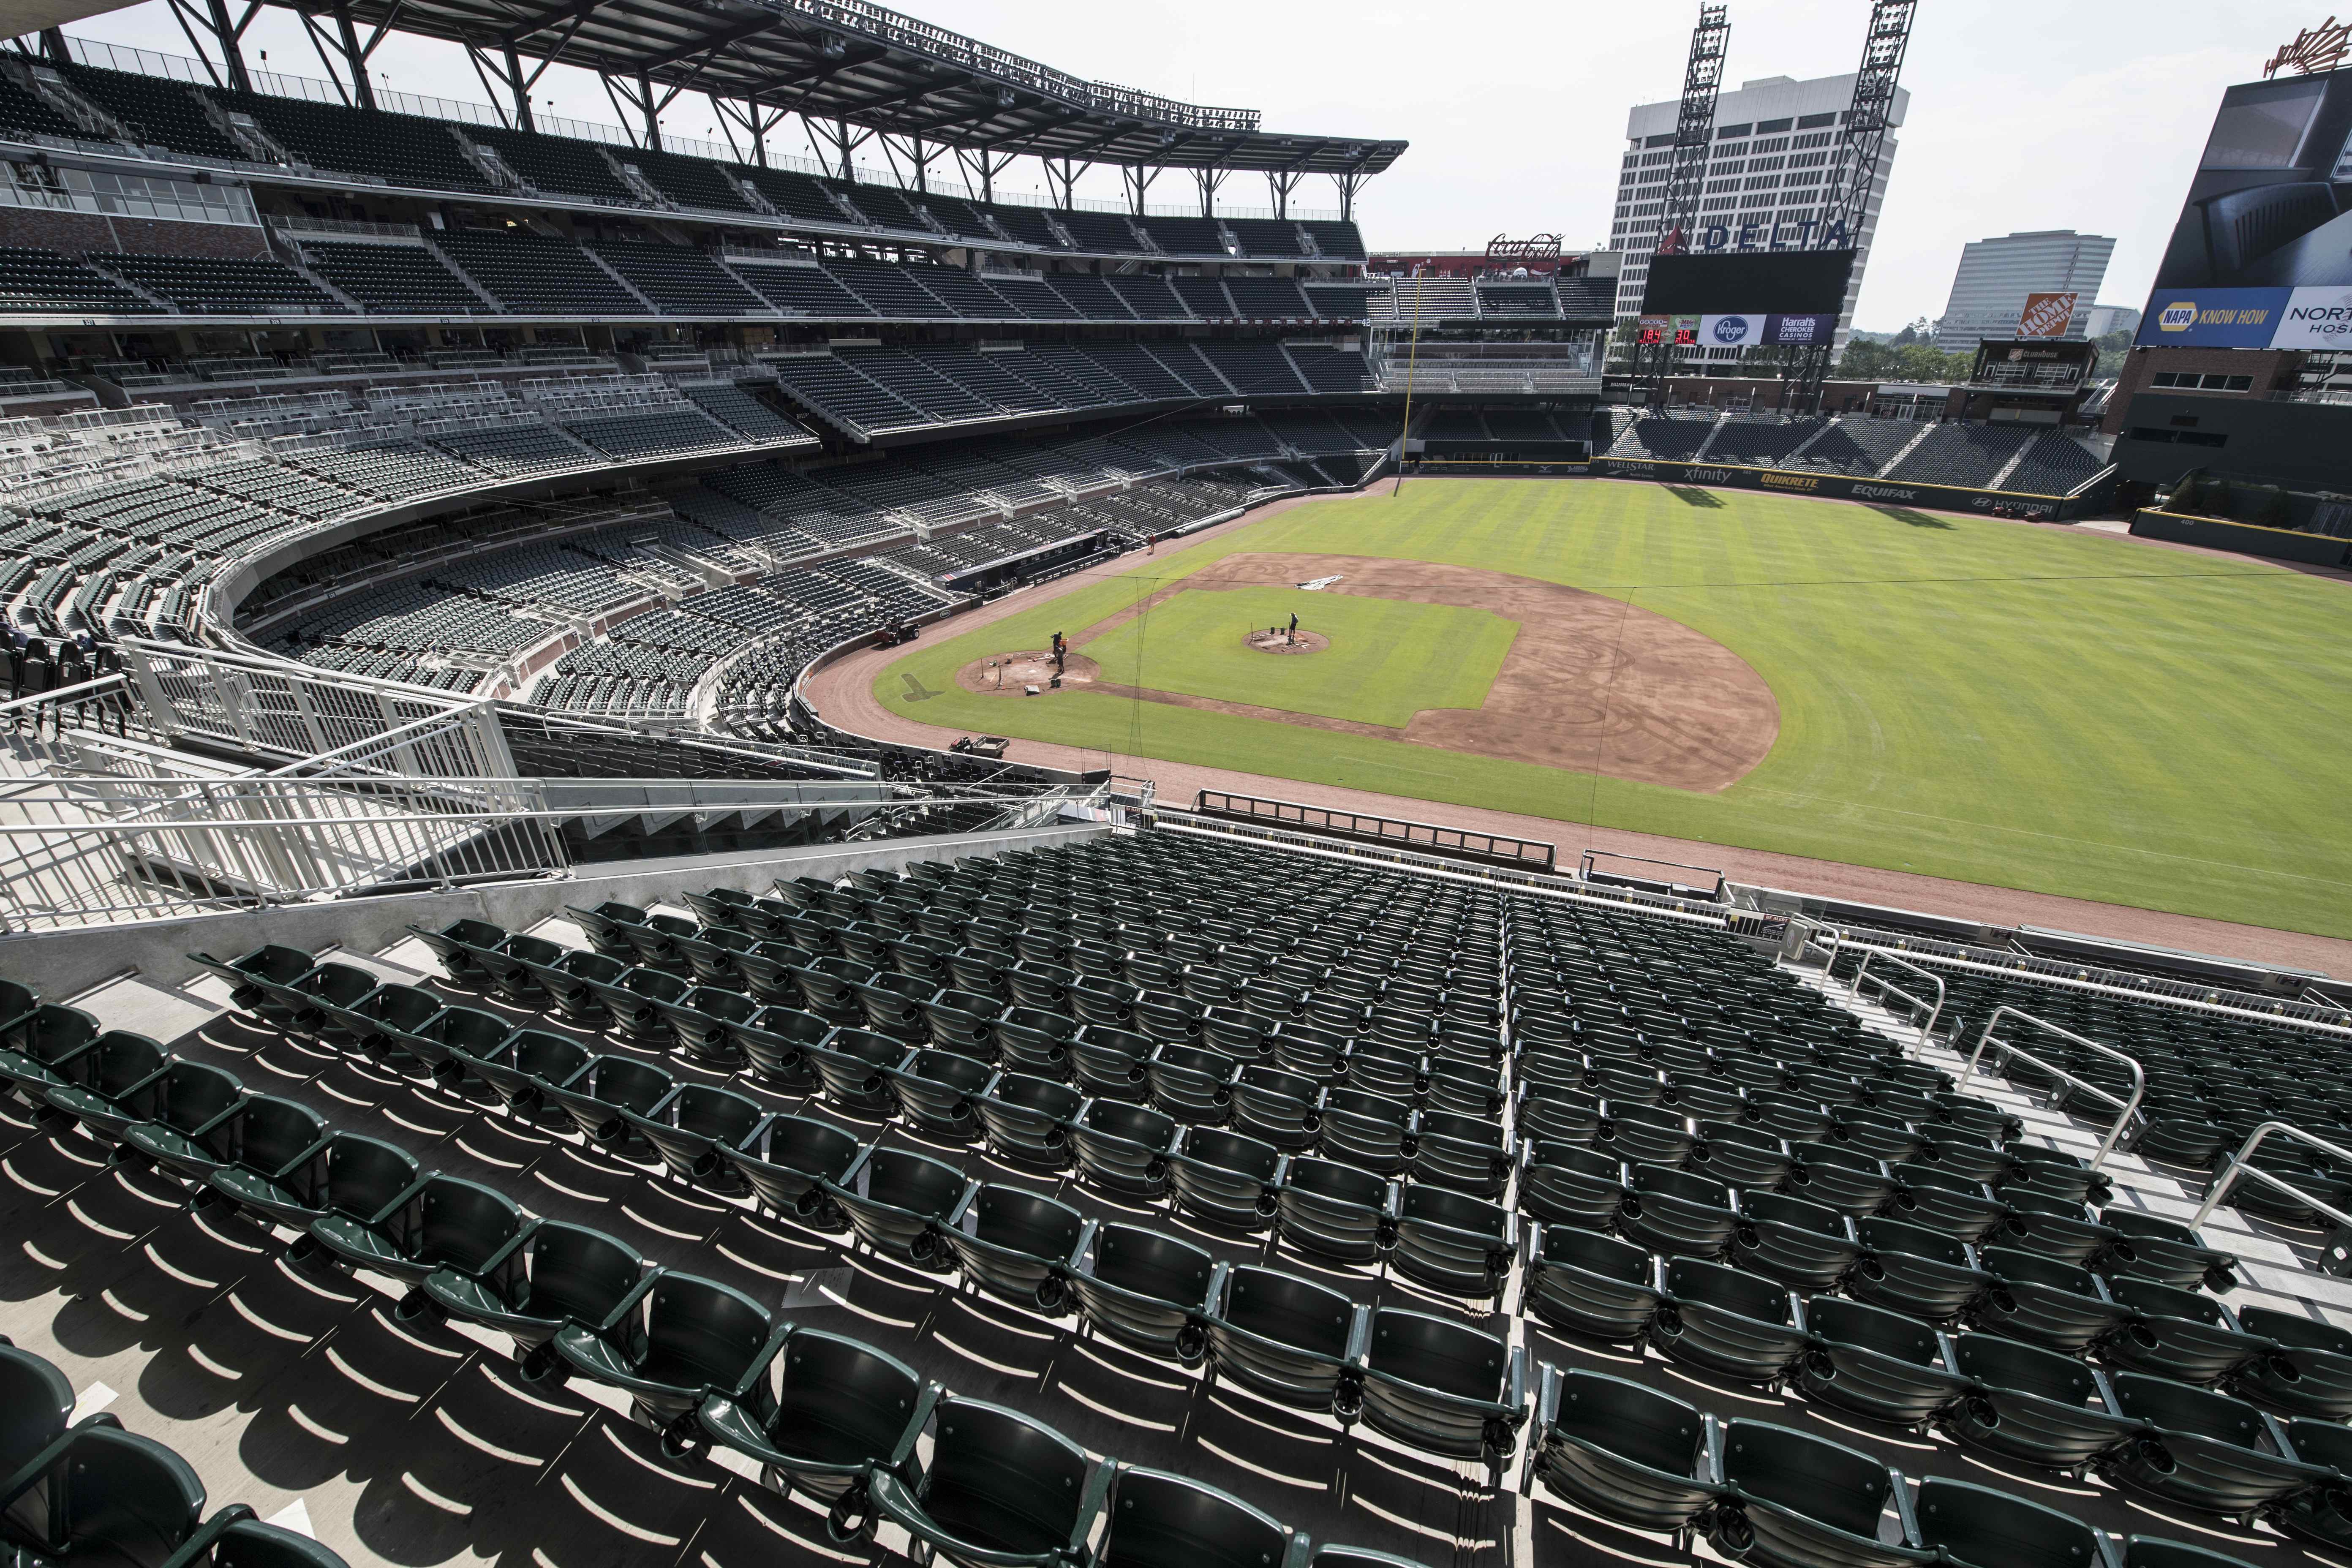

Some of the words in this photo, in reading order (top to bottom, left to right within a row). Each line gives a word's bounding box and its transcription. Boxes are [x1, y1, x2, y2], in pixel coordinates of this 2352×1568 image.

[1704, 219, 1849, 250] DELTA
[1485, 233, 1568, 261] Coca-Cola
[2019, 293, 2076, 335] HOME
[2028, 298, 2052, 315] THE
[1782, 317, 1816, 327] Harrah's
[2036, 310, 2071, 335] DEPOT
[2163, 310, 2192, 324] NAPA
[2199, 310, 2236, 324] KNOW
[2237, 309, 2269, 324] HOW
[1643, 330, 1661, 339] 184
[1676, 329, 1690, 340] 30
[1718, 320, 1746, 340] Kroger
[2309, 325, 2352, 333] HOS
[1607, 461, 1655, 471] WELLSTAR
[1684, 466, 1732, 484] xfinity
[1761, 473, 1819, 487] QUIKRETE
[1851, 484, 1917, 500] EQUIFAX
[1995, 500, 2053, 513] HYUNDAI
